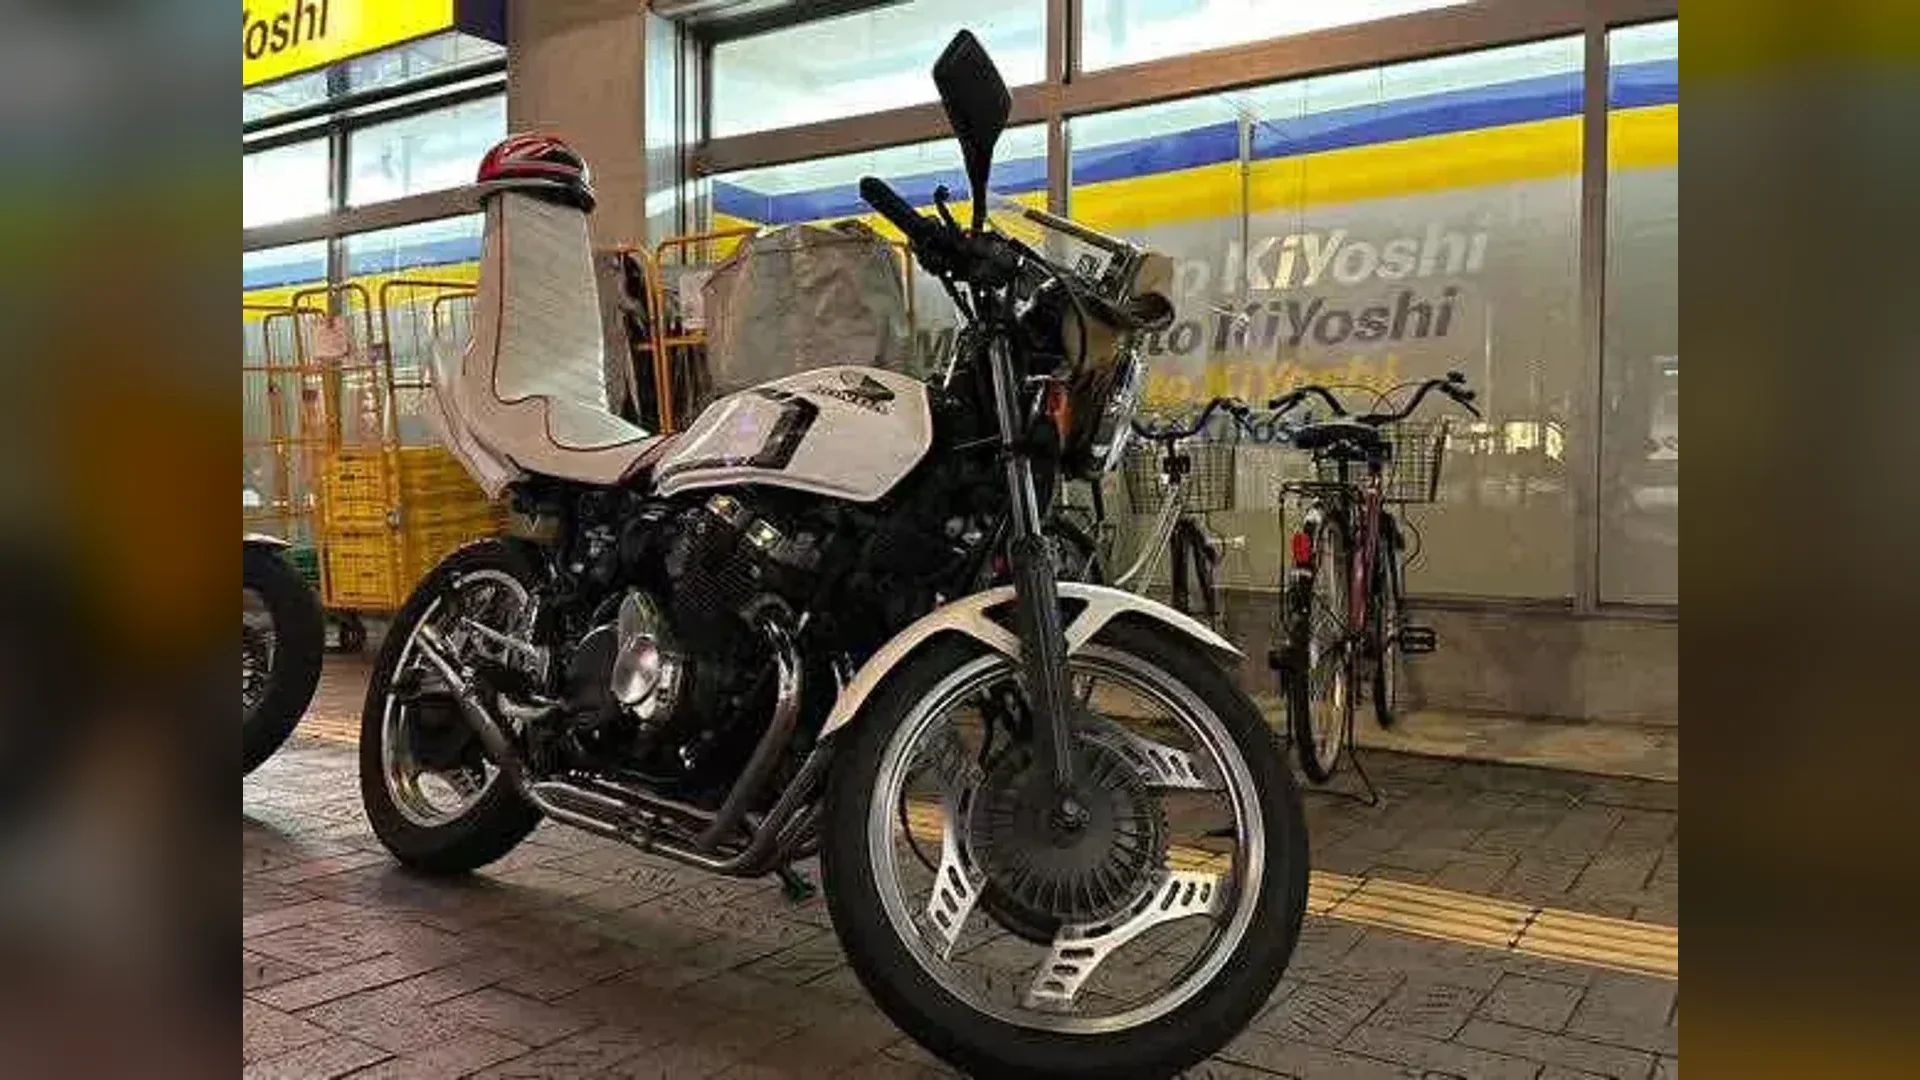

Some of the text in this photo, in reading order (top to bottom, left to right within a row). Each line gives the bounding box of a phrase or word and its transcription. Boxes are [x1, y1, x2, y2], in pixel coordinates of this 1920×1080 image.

[243, 0, 329, 60] oshi
[1220, 218, 1490, 293] KiYoshi
[1213, 285, 1461, 356] KiYoshi
